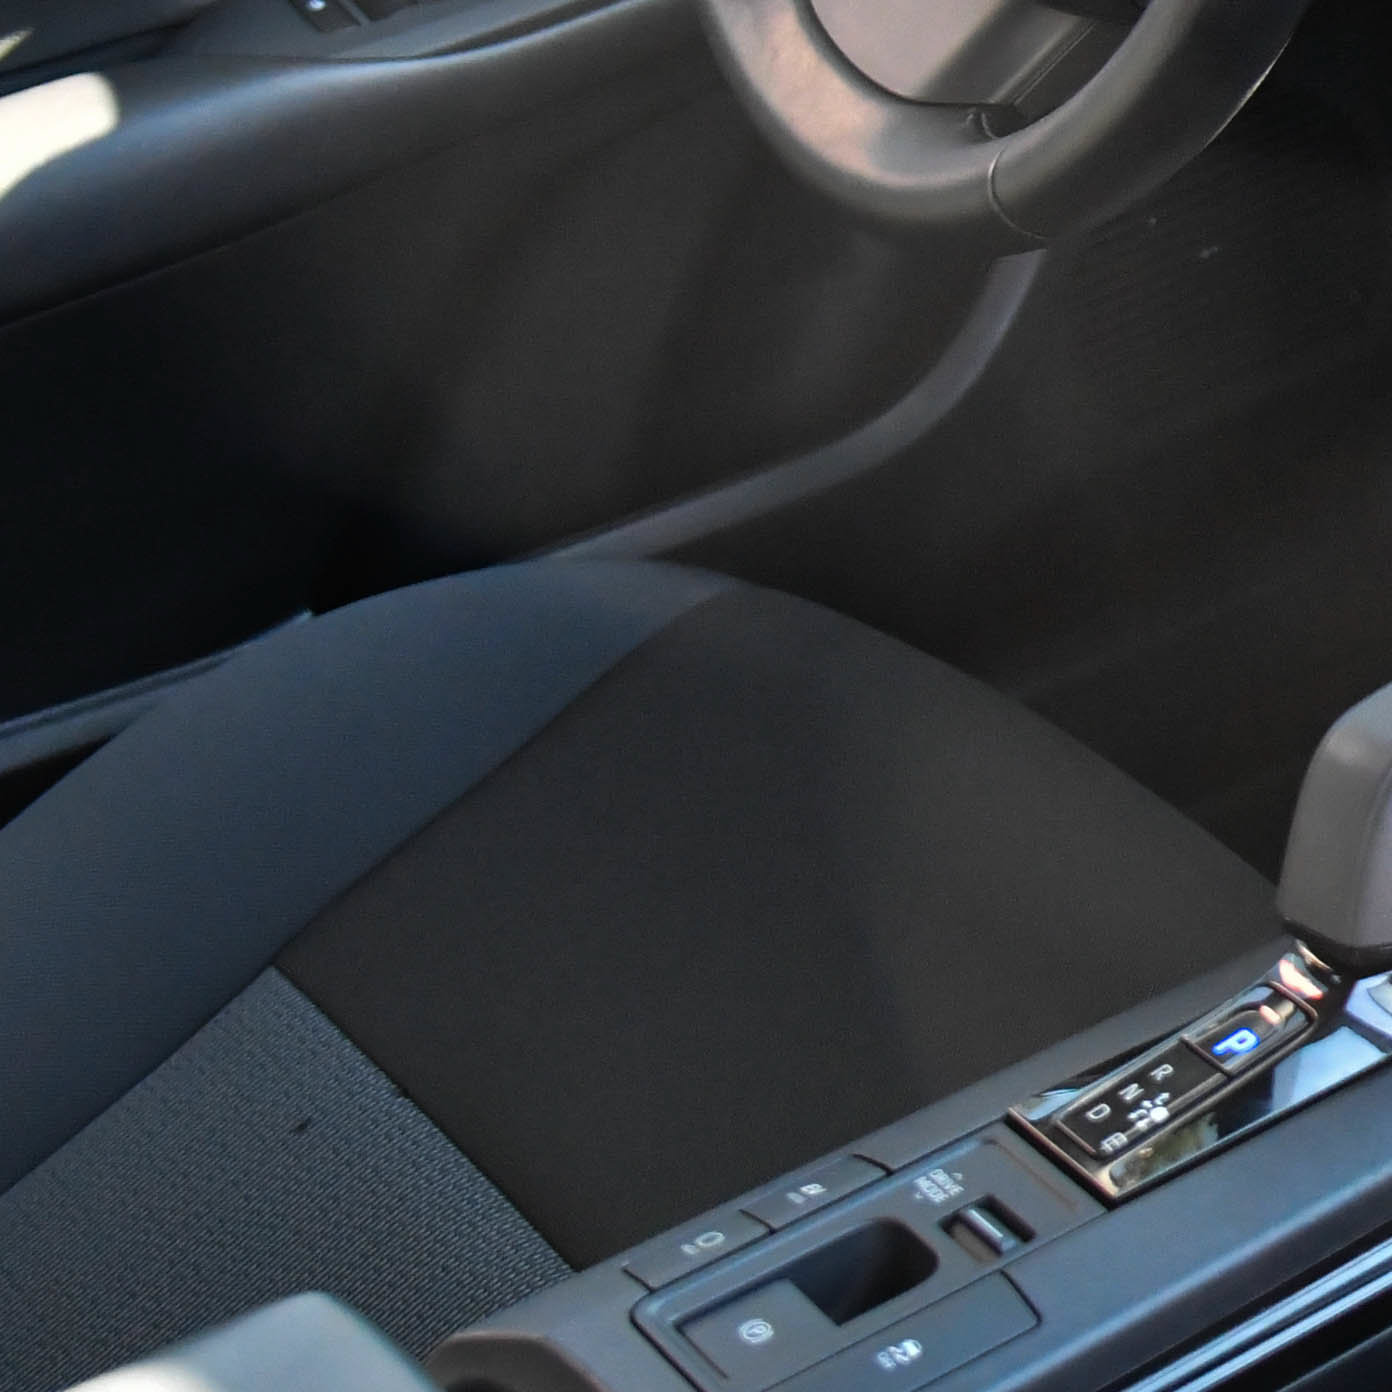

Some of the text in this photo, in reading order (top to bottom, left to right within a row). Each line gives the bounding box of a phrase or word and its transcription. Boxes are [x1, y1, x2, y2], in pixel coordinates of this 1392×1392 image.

[1211, 1026, 1262, 1056] P
[1150, 1063, 1175, 1081] R
[1118, 1082, 1145, 1101] N
[1085, 1103, 1112, 1120] D
[913, 1176, 950, 1204] MODE
